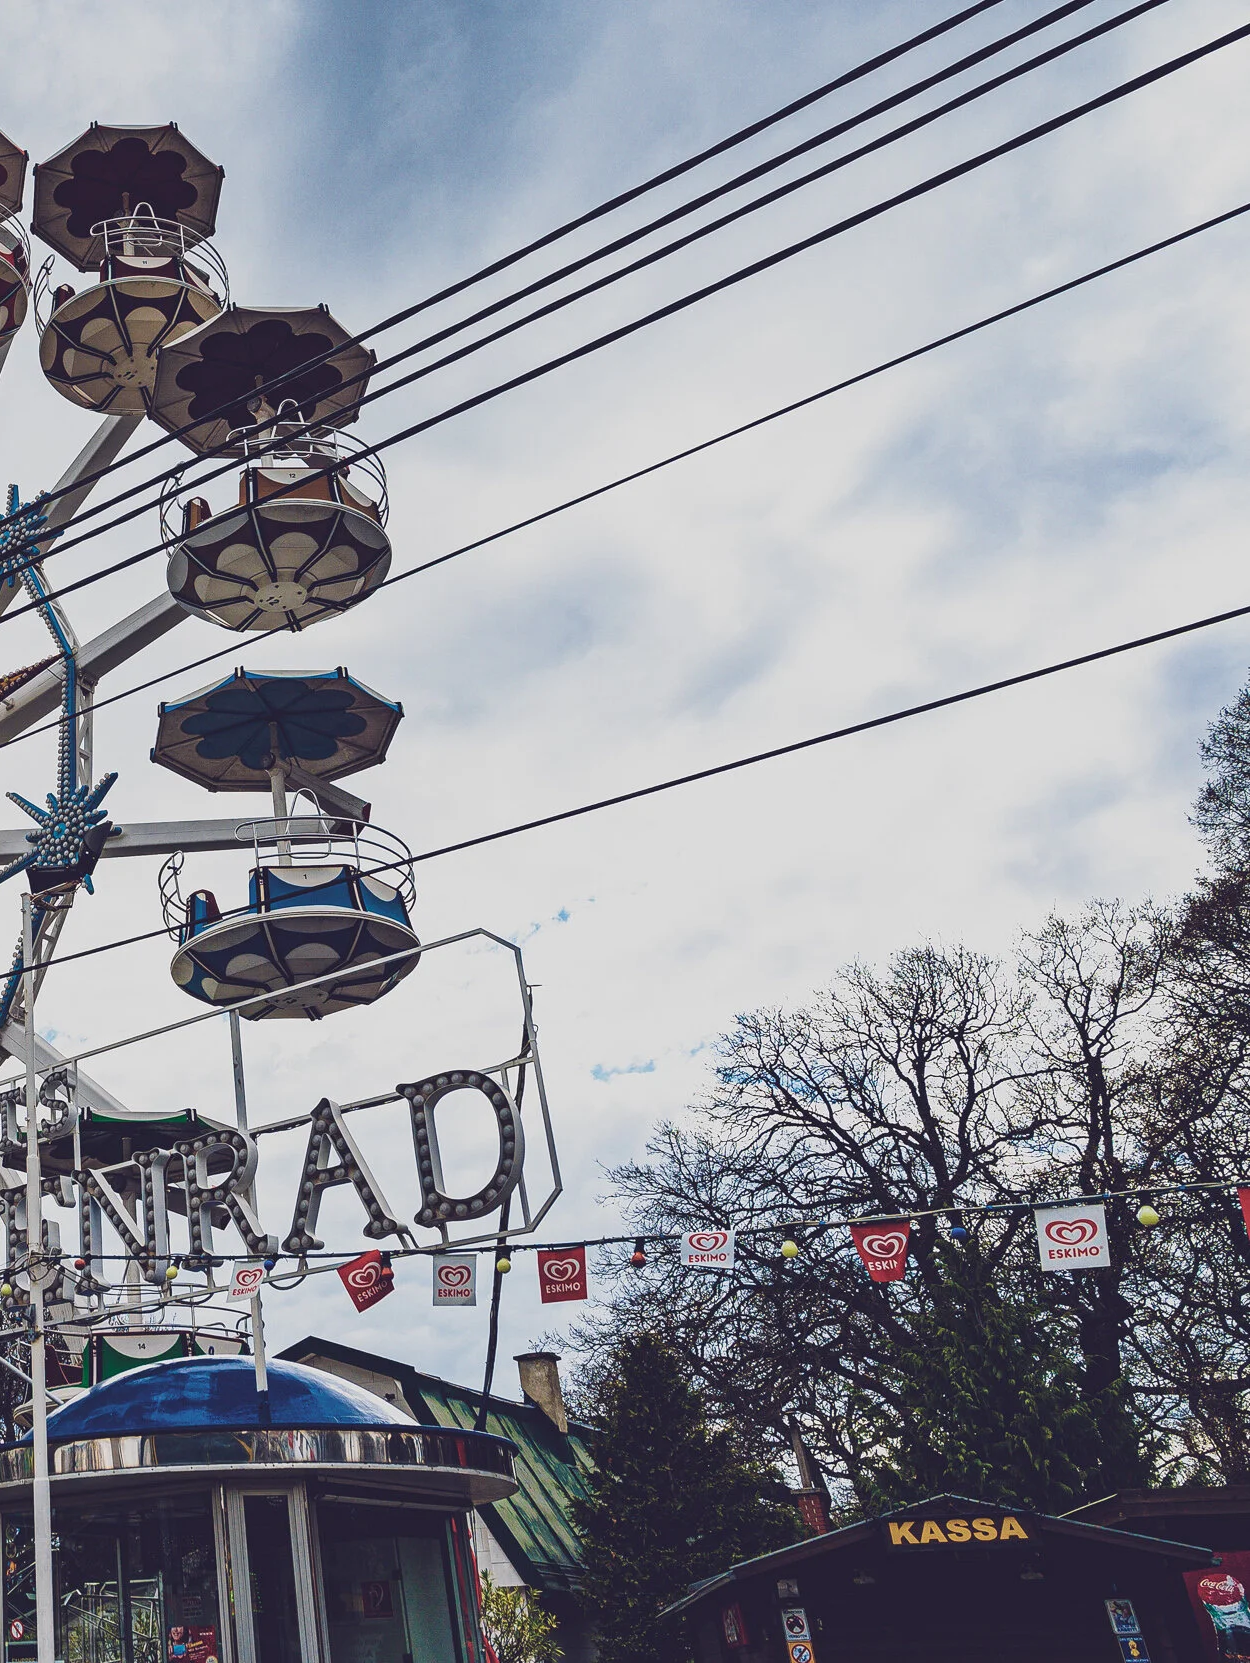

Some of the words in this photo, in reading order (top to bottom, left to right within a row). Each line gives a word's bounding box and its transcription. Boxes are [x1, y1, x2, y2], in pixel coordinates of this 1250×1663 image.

[1048, 1246, 1100, 1259] ESKIMO
[688, 1254, 727, 1263] ESKIMO
[232, 1286, 258, 1296] ESKIMO
[357, 1280, 388, 1302] ESKIMO
[438, 1289, 470, 1297] ESKIMO
[546, 1283, 581, 1294] ESKIMO
[888, 1516, 1029, 1545] KASSA
